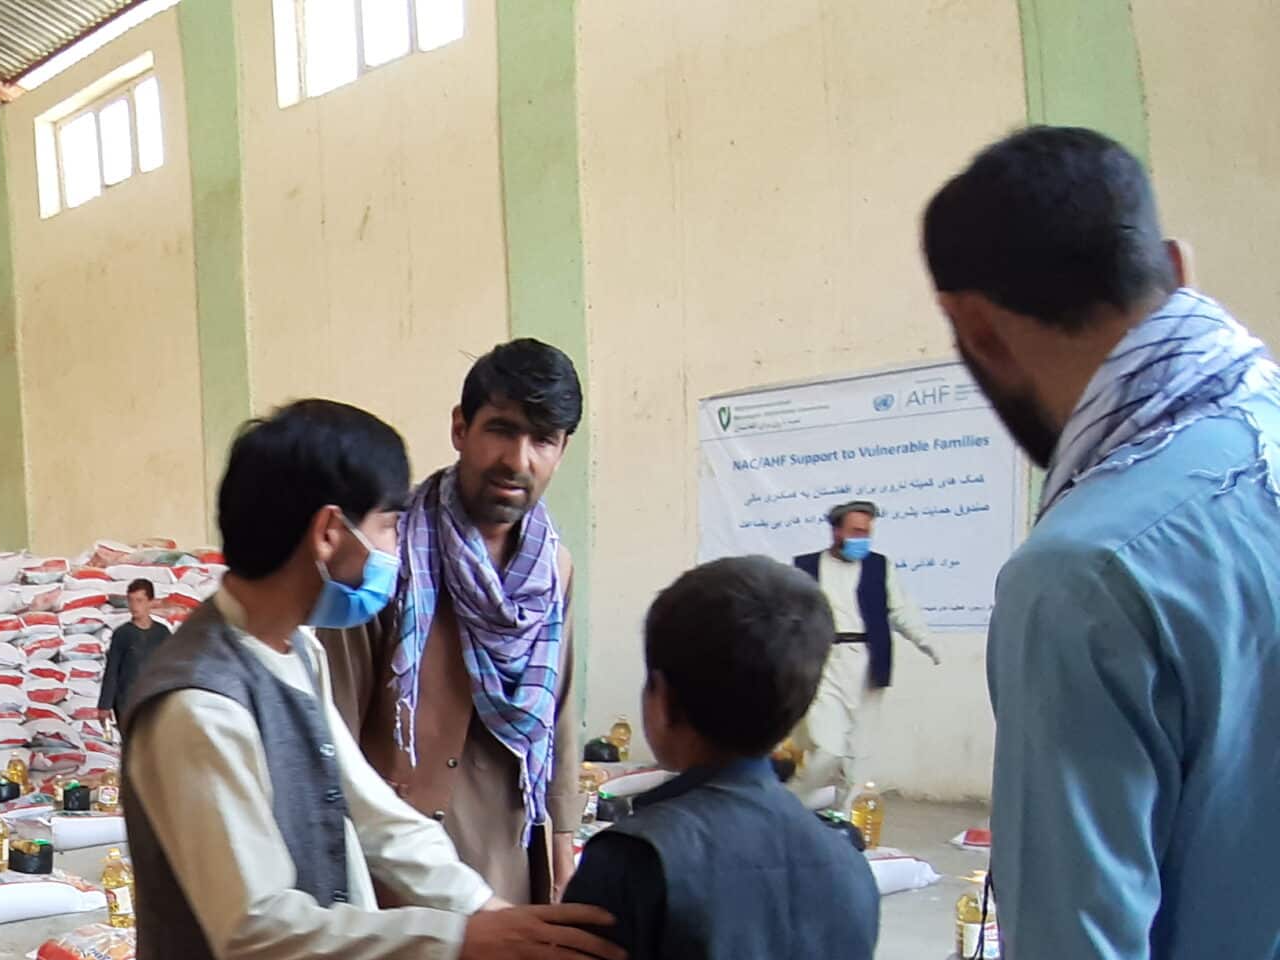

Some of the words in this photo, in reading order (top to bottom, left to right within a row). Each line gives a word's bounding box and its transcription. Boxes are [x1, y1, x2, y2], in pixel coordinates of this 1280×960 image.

[906, 384, 951, 408] AHF
[732, 456, 787, 471] NAC/AHF
[790, 450, 838, 467] Support
[842, 449, 856, 460] to
[858, 439, 929, 458] Vulnerable
[933, 434, 990, 451] Families
